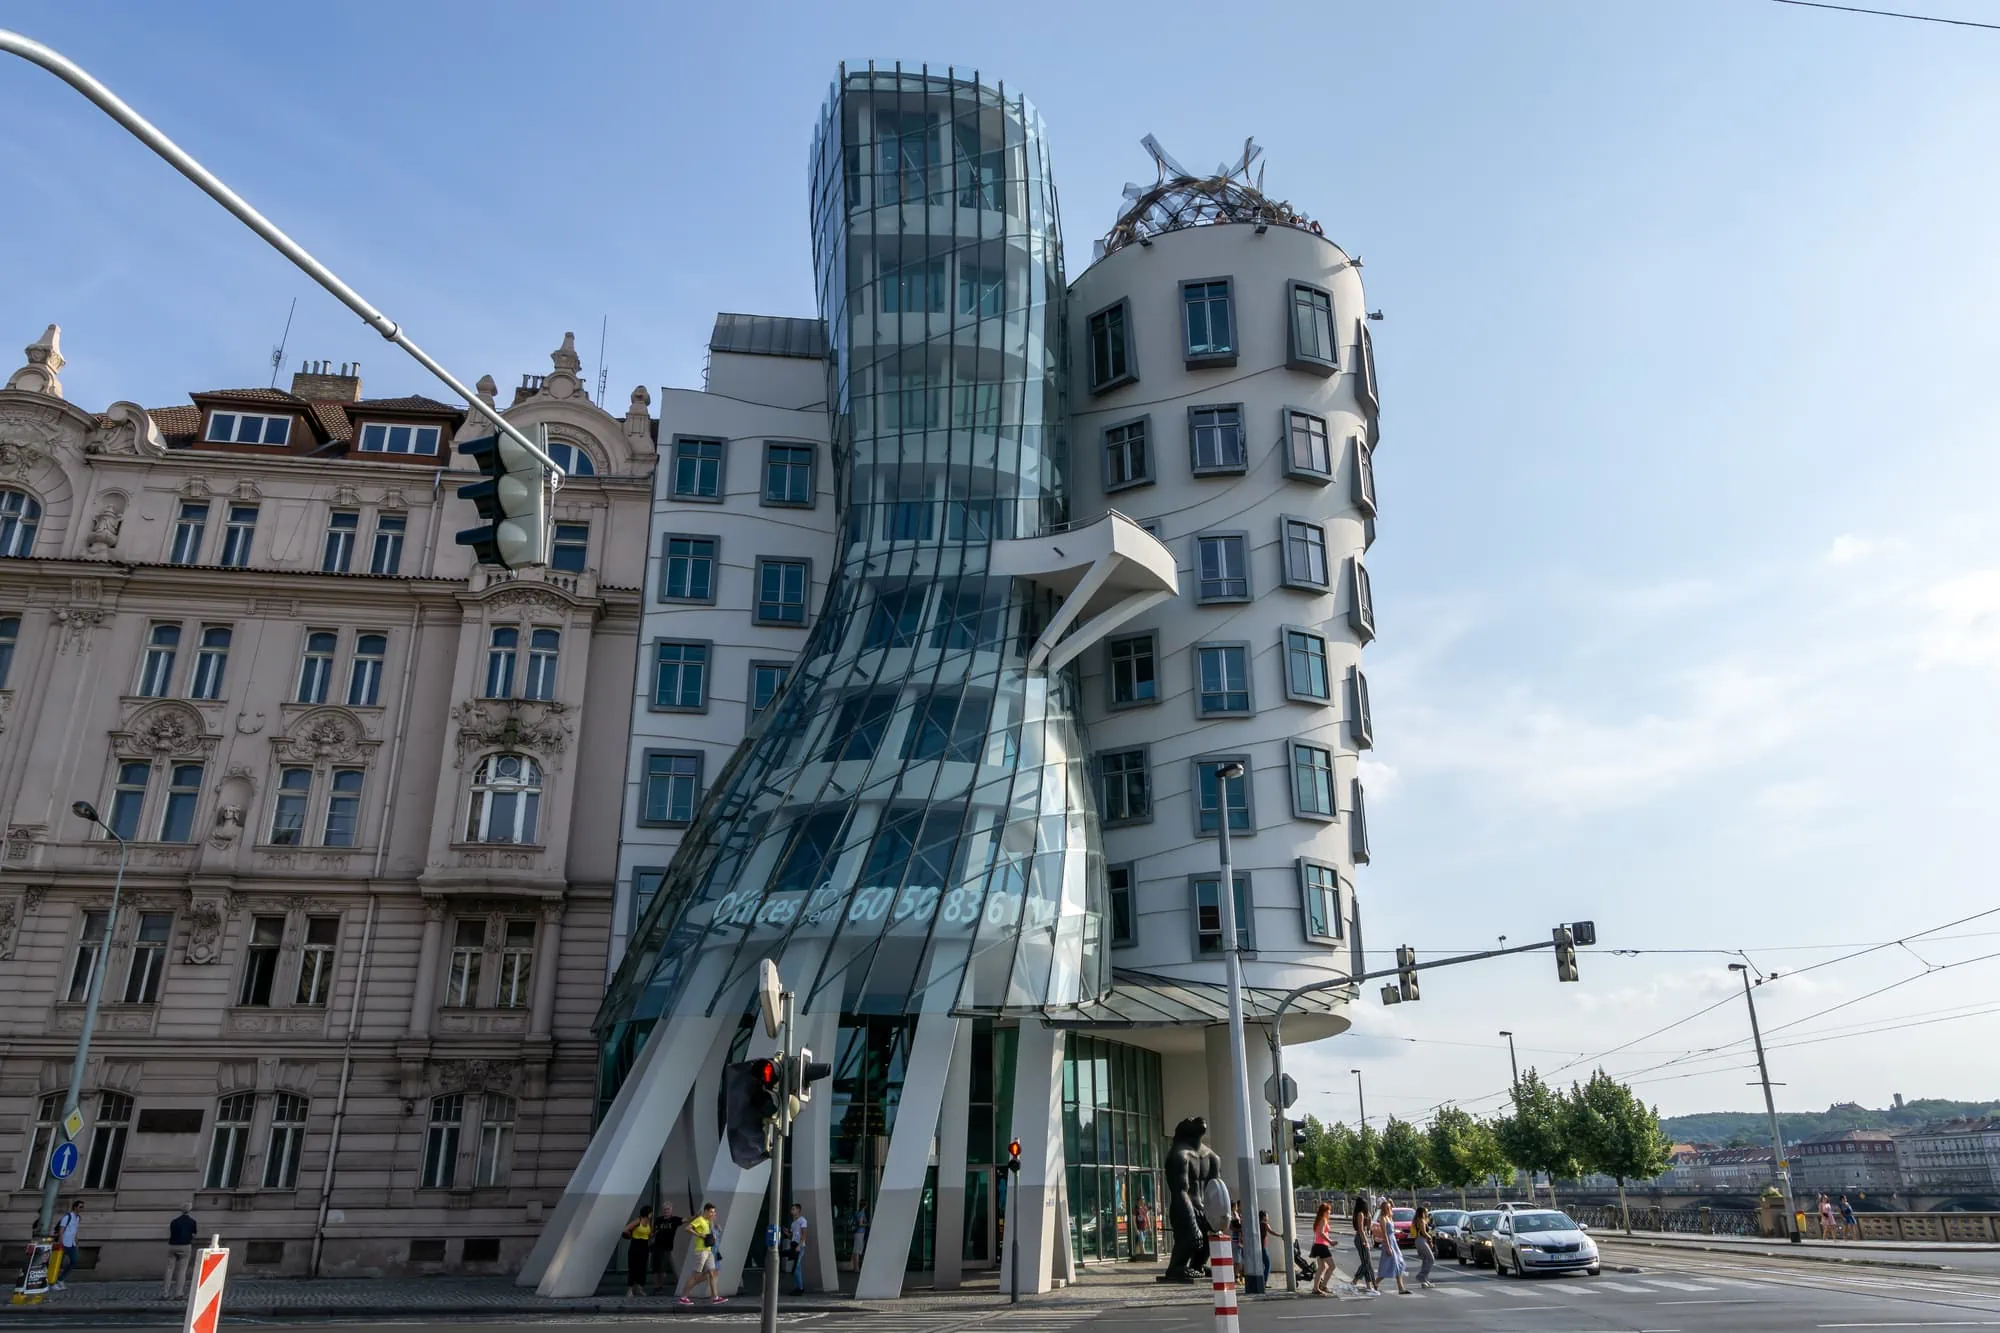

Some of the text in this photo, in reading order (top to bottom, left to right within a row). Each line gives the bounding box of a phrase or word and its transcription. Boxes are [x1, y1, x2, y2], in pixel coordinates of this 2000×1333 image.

[712, 889, 802, 926] Offices
[849, 886, 894, 920] 60
[895, 885, 938, 920] 50
[944, 888, 980, 923] 83
